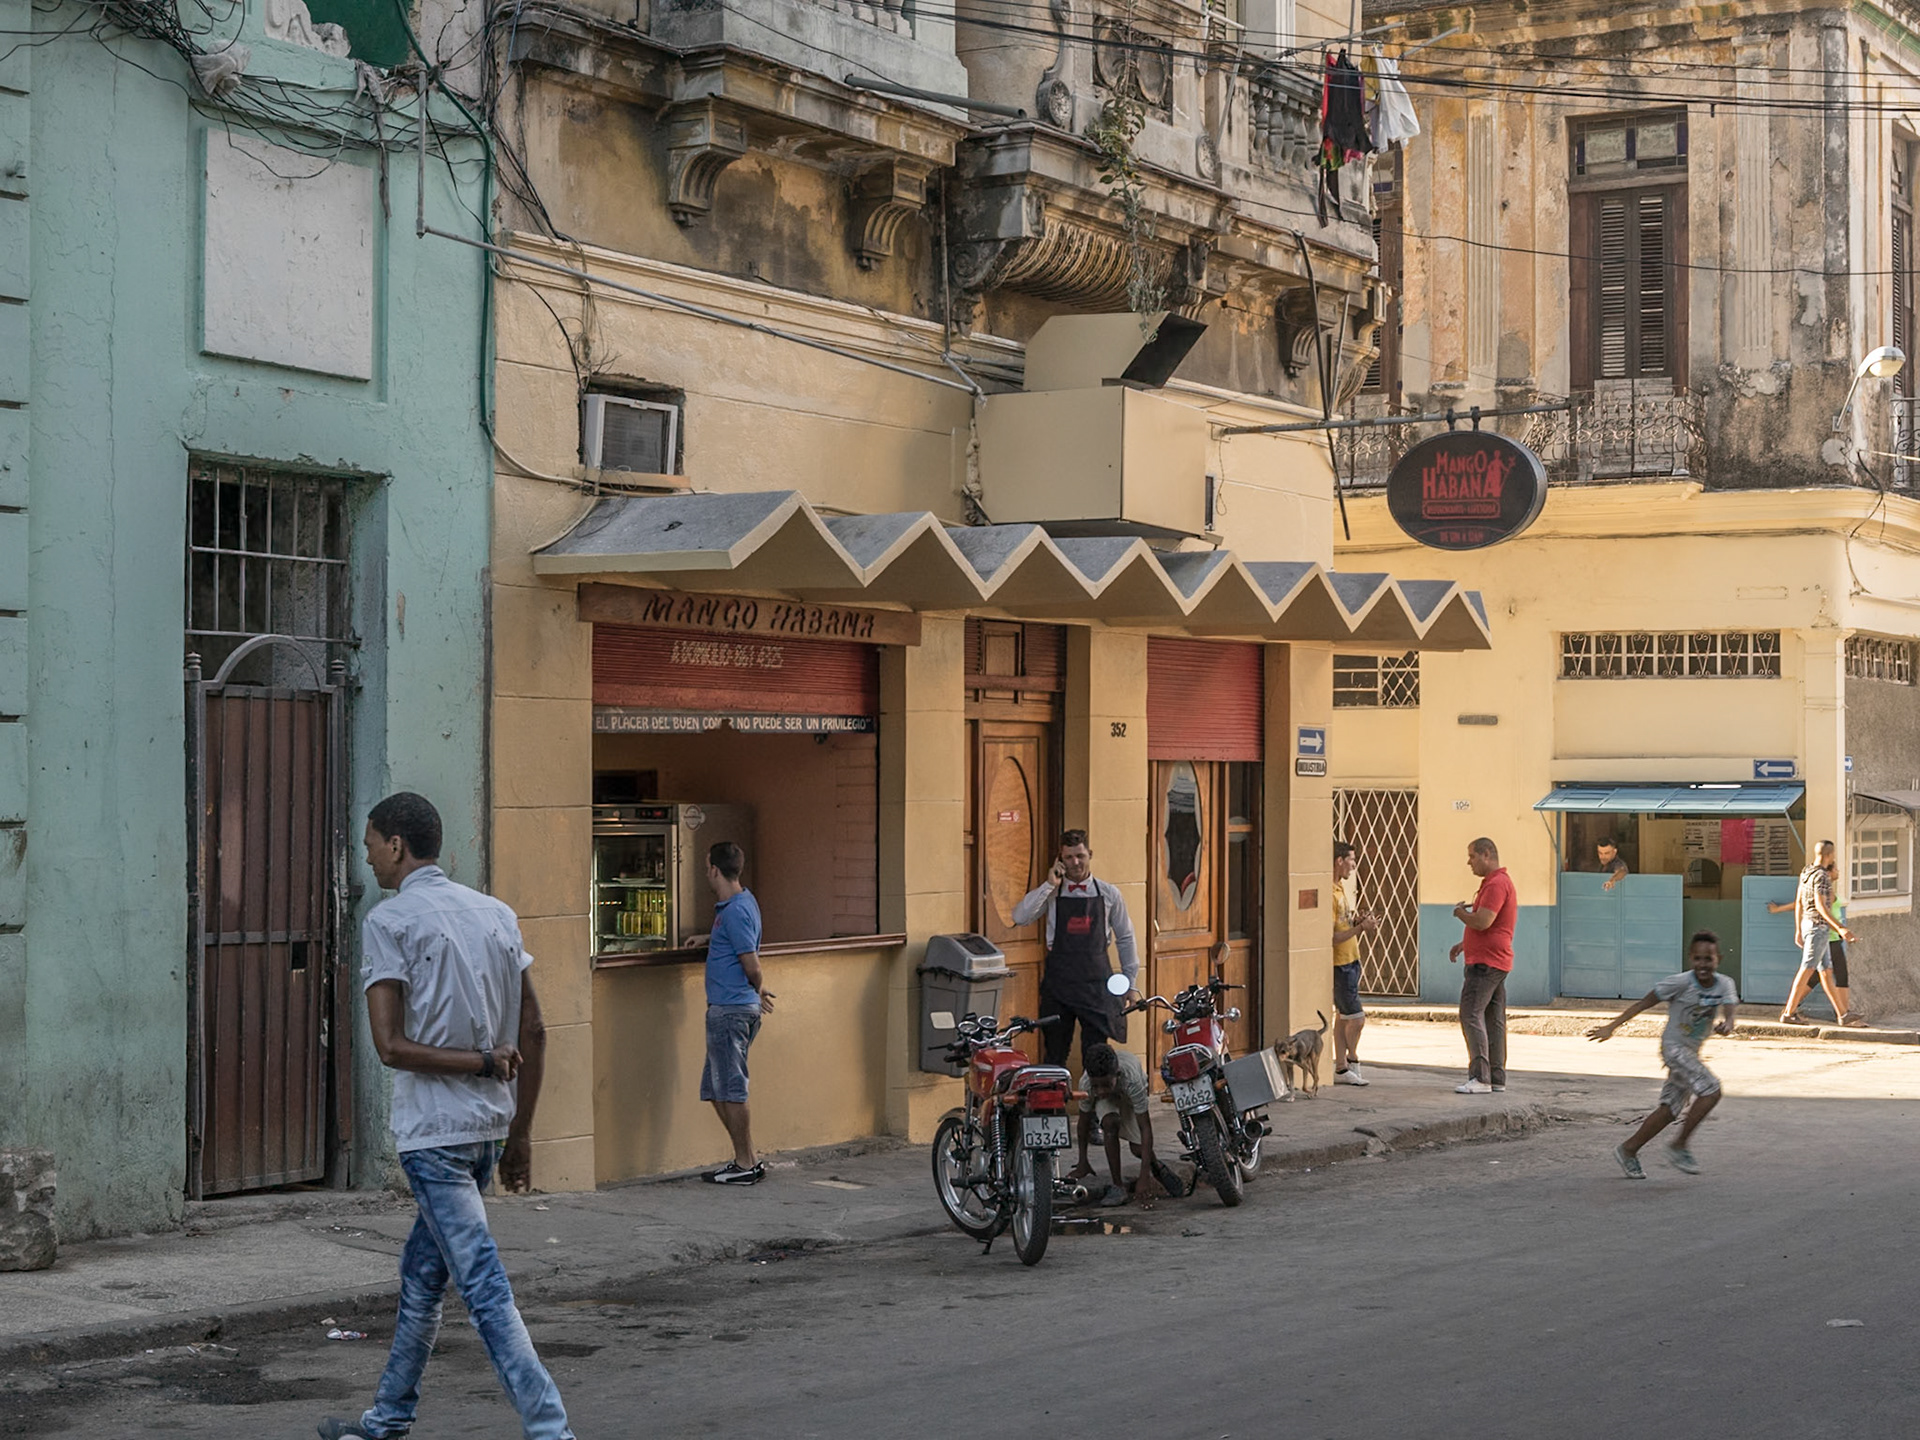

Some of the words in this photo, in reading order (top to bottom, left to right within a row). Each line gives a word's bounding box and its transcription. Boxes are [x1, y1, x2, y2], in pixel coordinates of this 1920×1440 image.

[1436, 450, 1488, 475] MANGO
[1422, 466, 1501, 499] HABANA
[642, 594, 759, 630] MANGO
[770, 604, 875, 638] HABANA
[595, 716, 609, 730] EL
[611, 716, 649, 730] PLACER
[651, 716, 670, 730] DEL
[672, 716, 700, 730] BUEN
[702, 716, 735, 730] COMR
[737, 716, 751, 730] NO
[752, 716, 782, 730] PUEDE
[784, 716, 803, 730] SER
[805, 717, 820, 731] UN
[1110, 721, 1127, 738] 352
[1187, 1081, 1196, 1093] R
[1177, 1089, 1212, 1109] 04652
[1041, 1115, 1050, 1130] R
[1025, 1130, 1068, 1146] 03345
